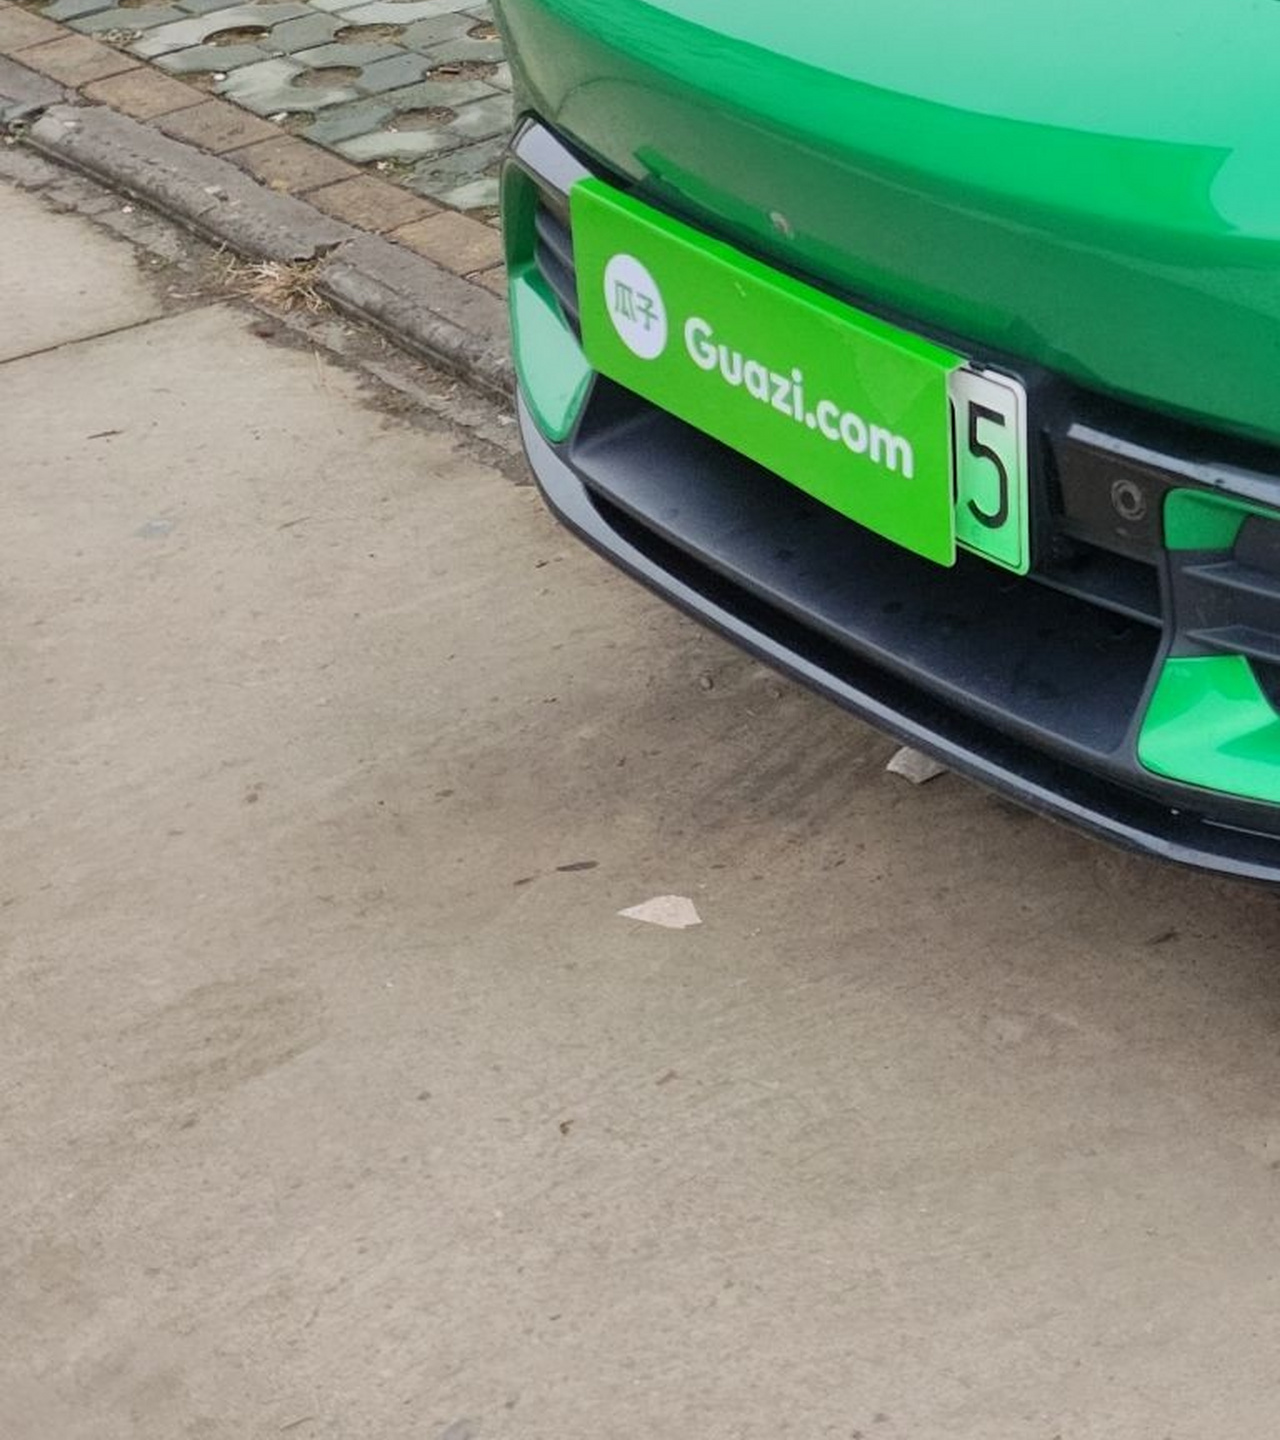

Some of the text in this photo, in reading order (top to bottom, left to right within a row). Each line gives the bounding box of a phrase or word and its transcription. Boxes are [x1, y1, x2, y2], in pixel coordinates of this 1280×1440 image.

[612, 279, 660, 333] 瓜子
[683, 316, 914, 481] Guazi.com
[965, 399, 1010, 530] 5
